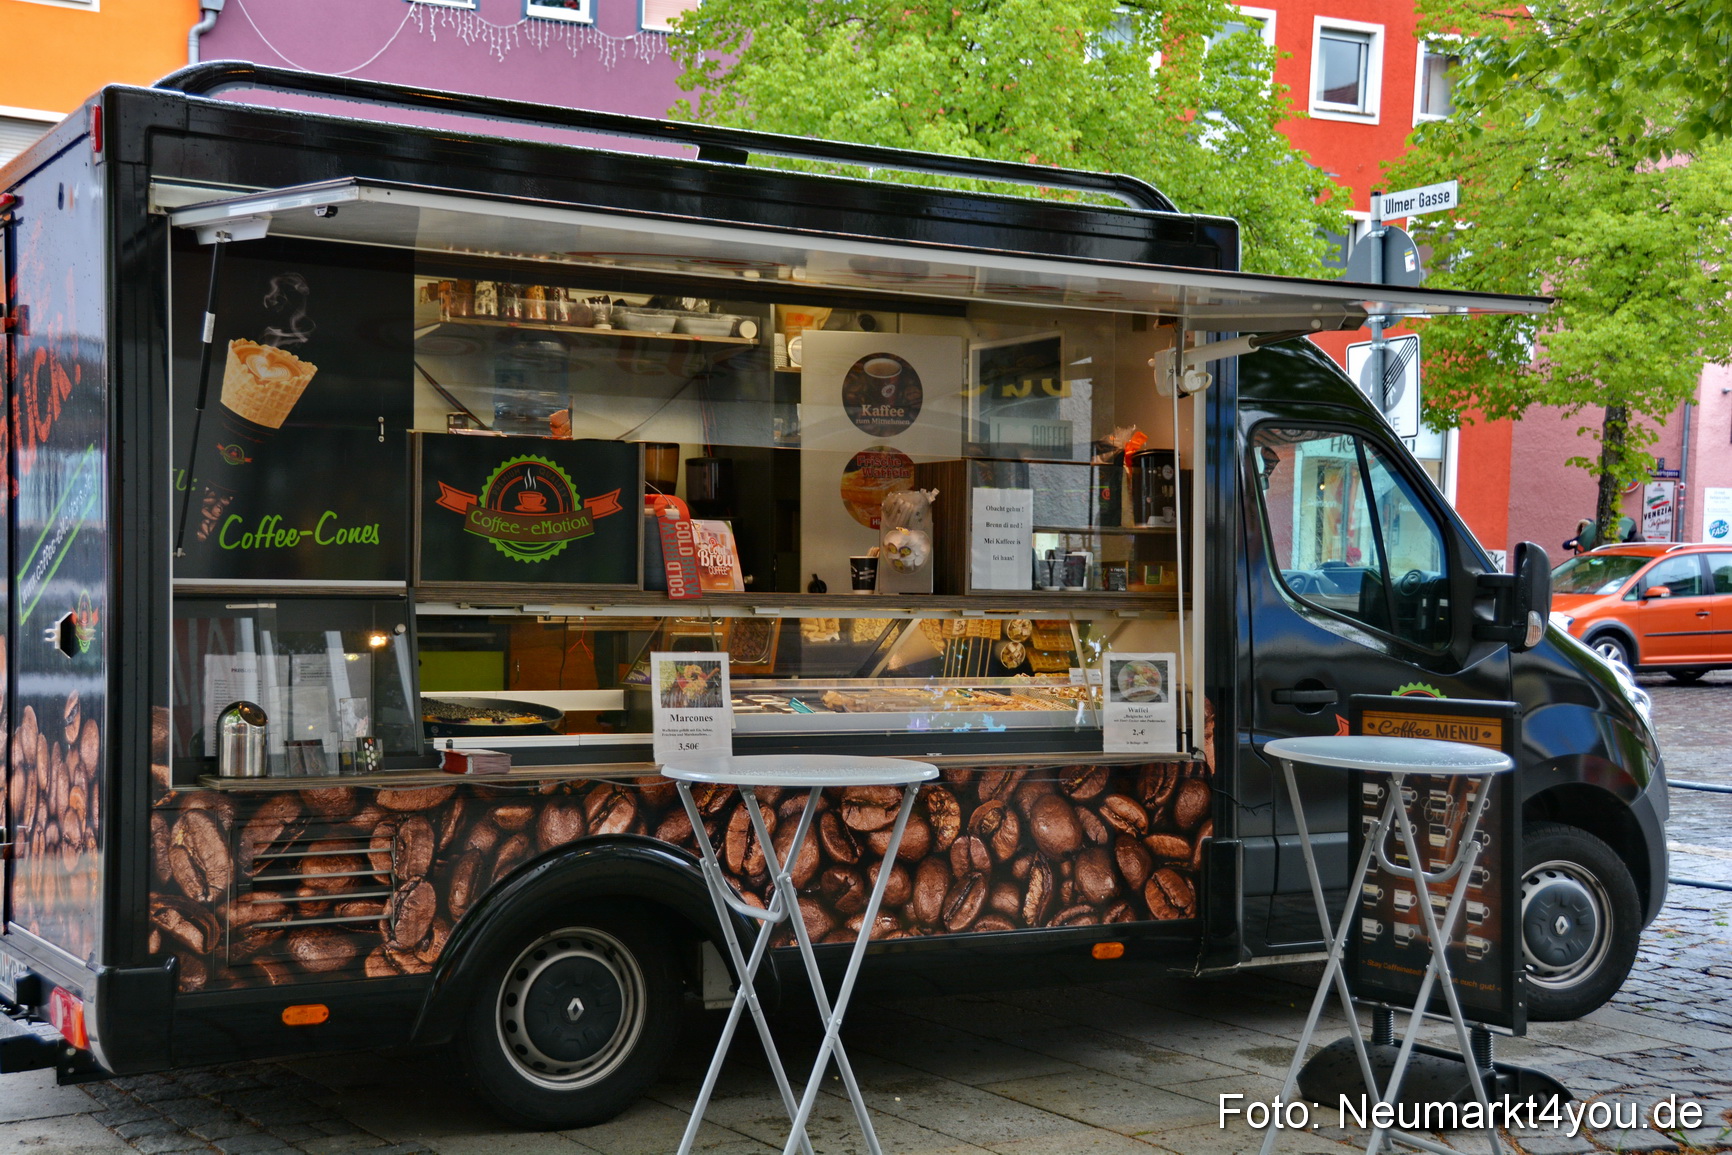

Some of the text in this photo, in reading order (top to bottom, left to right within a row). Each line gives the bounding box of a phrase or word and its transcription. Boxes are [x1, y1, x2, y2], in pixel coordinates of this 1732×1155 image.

[1385, 191, 1450, 215] Ulmer Gasse
[861, 404, 905, 417] Kaffee
[871, 417, 910, 425] Mitnehmen
[1032, 424, 1068, 452] COFFEE
[857, 454, 902, 467] Frische
[861, 466, 911, 478] Waffeln
[493, 468, 569, 498] PREMIUM QUALITY
[1643, 505, 1672, 521] VENEZIA
[218, 510, 381, 550] Coffee-Cones
[470, 510, 521, 534] Coffee
[531, 516, 590, 535] eMotion
[1711, 524, 1730, 538] FASS
[984, 537, 995, 545] Mei
[697, 549, 734, 567] Brew
[708, 565, 728, 576] COFFEE
[669, 713, 714, 722] Marcones
[1378, 719, 1479, 741] Coffee MENU
[677, 742, 700, 751] 3,50€
[1366, 959, 1382, 969] Stay
[1460, 979, 1478, 988] euch
[1479, 983, 1496, 992] gut!
